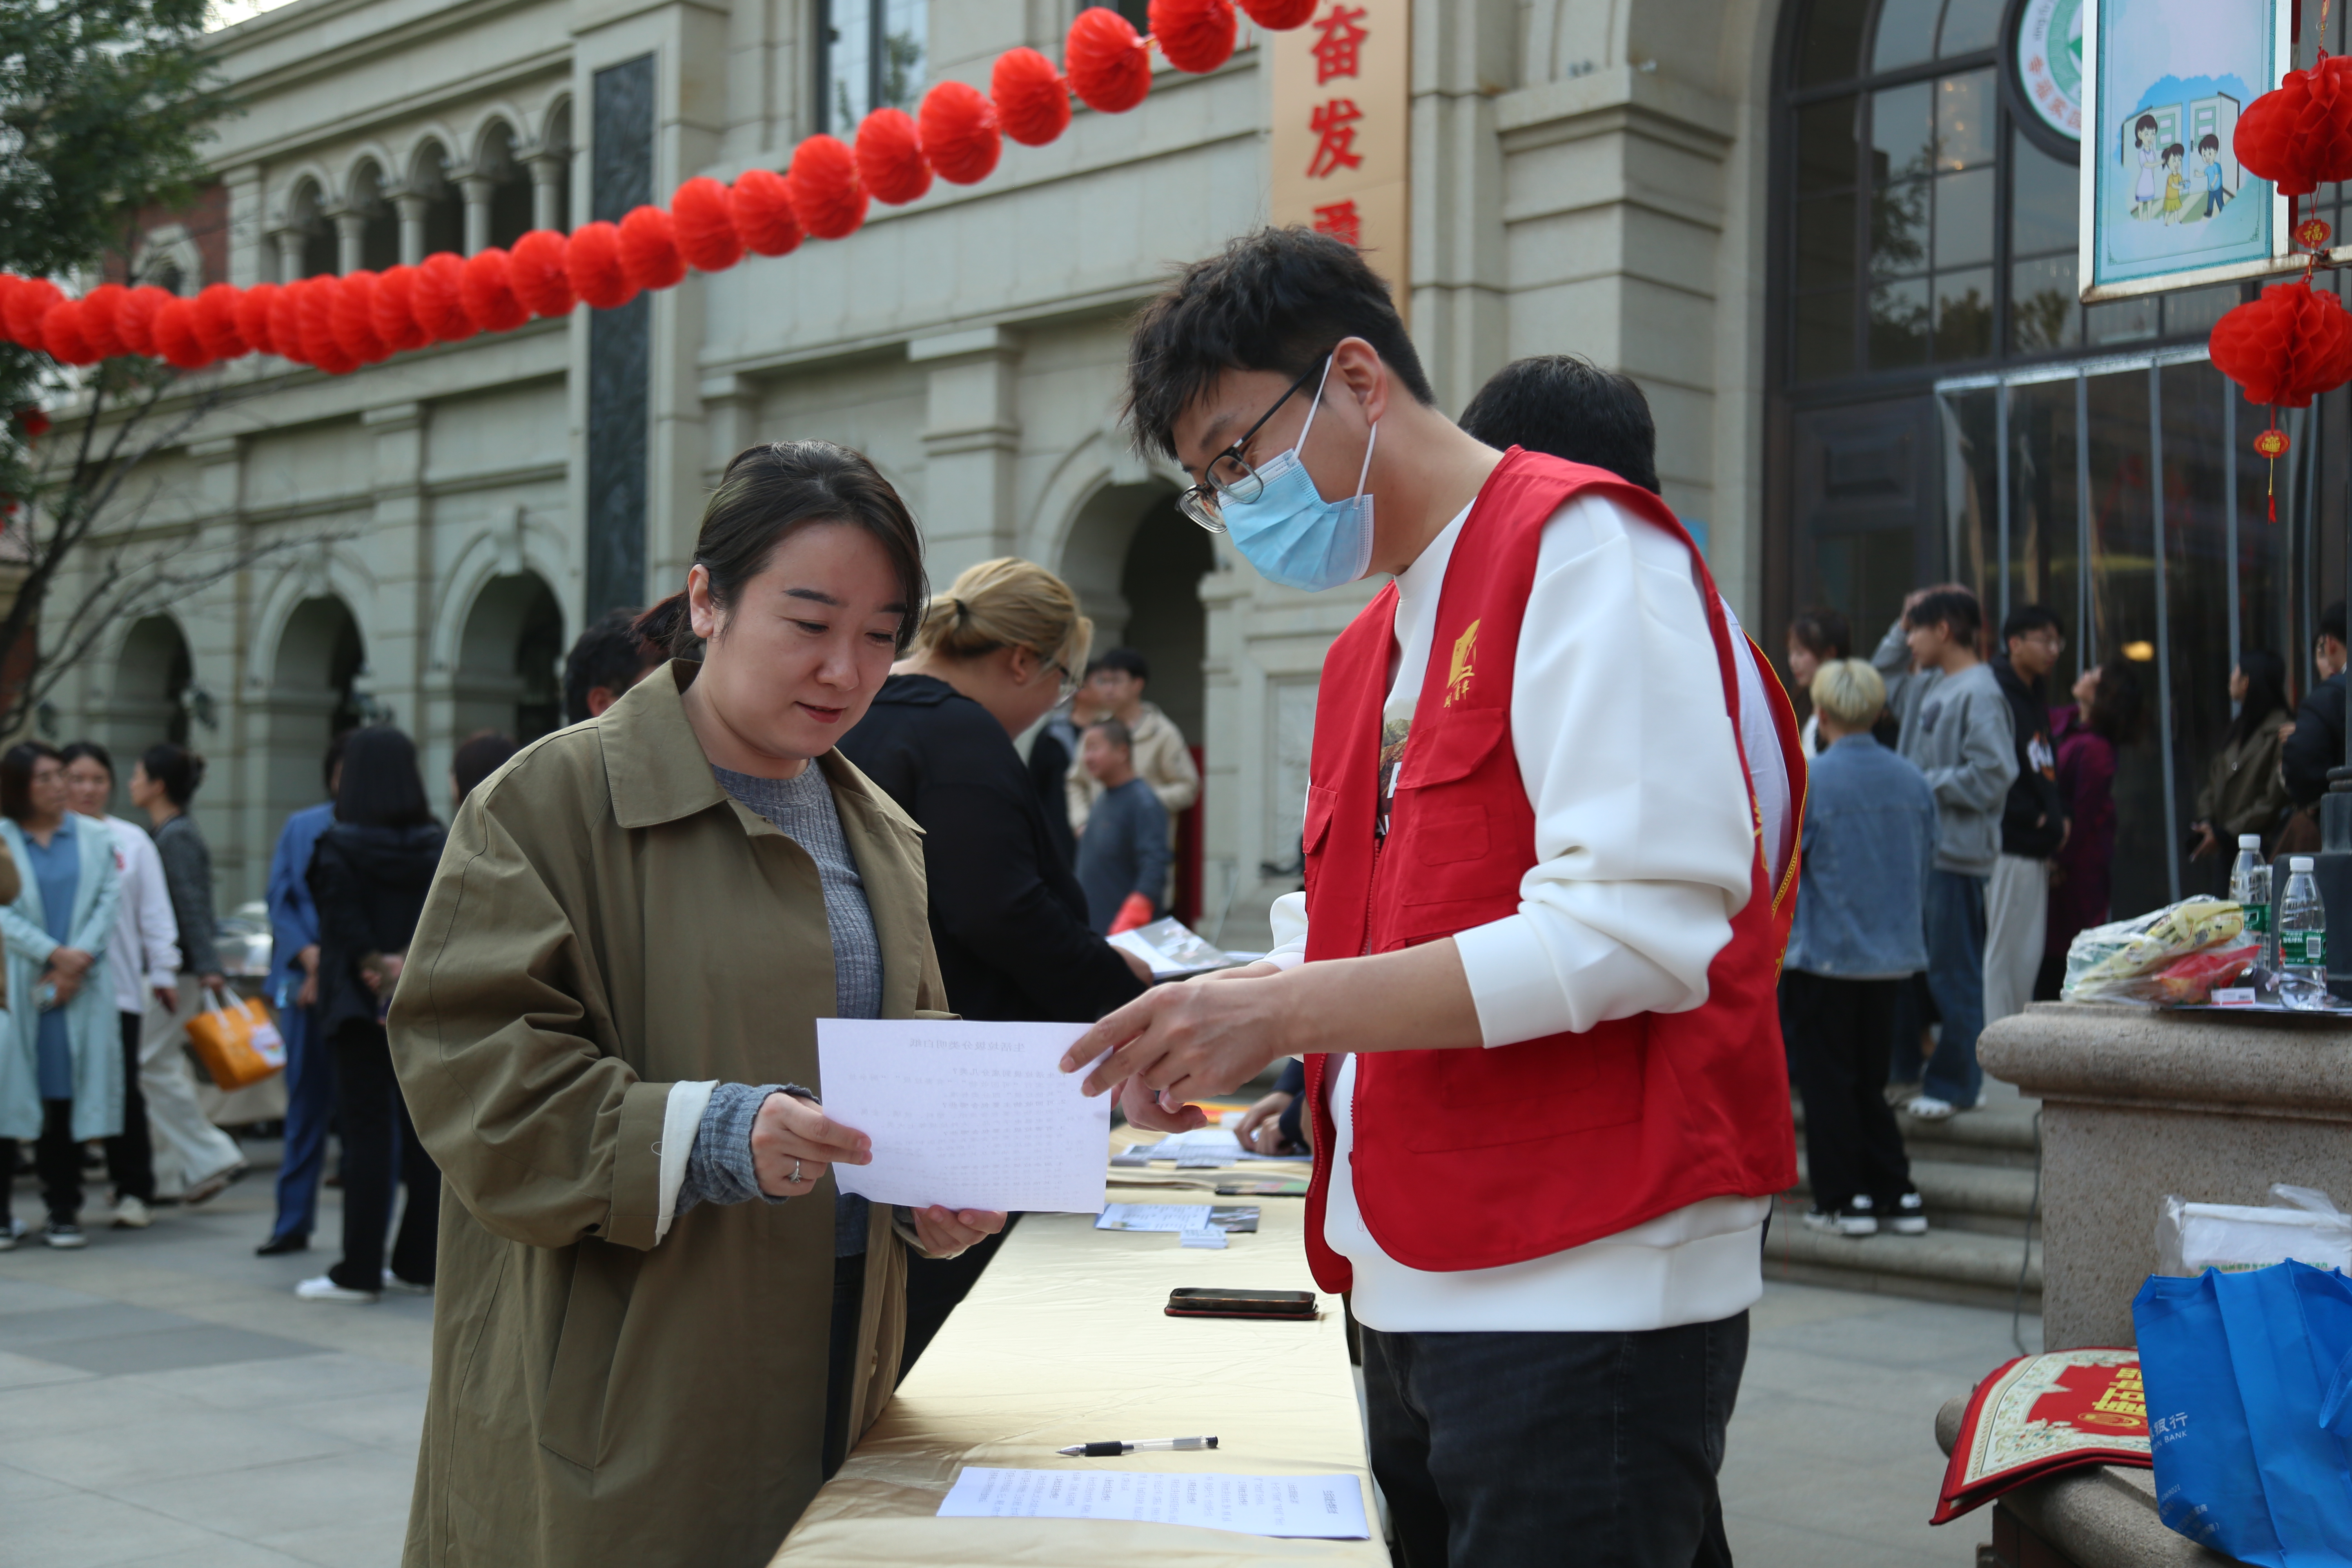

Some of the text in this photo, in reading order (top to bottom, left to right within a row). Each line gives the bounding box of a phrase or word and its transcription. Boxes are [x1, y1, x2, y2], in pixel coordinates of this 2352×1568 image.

[2303, 224, 2323, 243] 福
[2149, 1412, 2188, 1441] 银行
[2165, 1430, 2187, 1443] BANK
